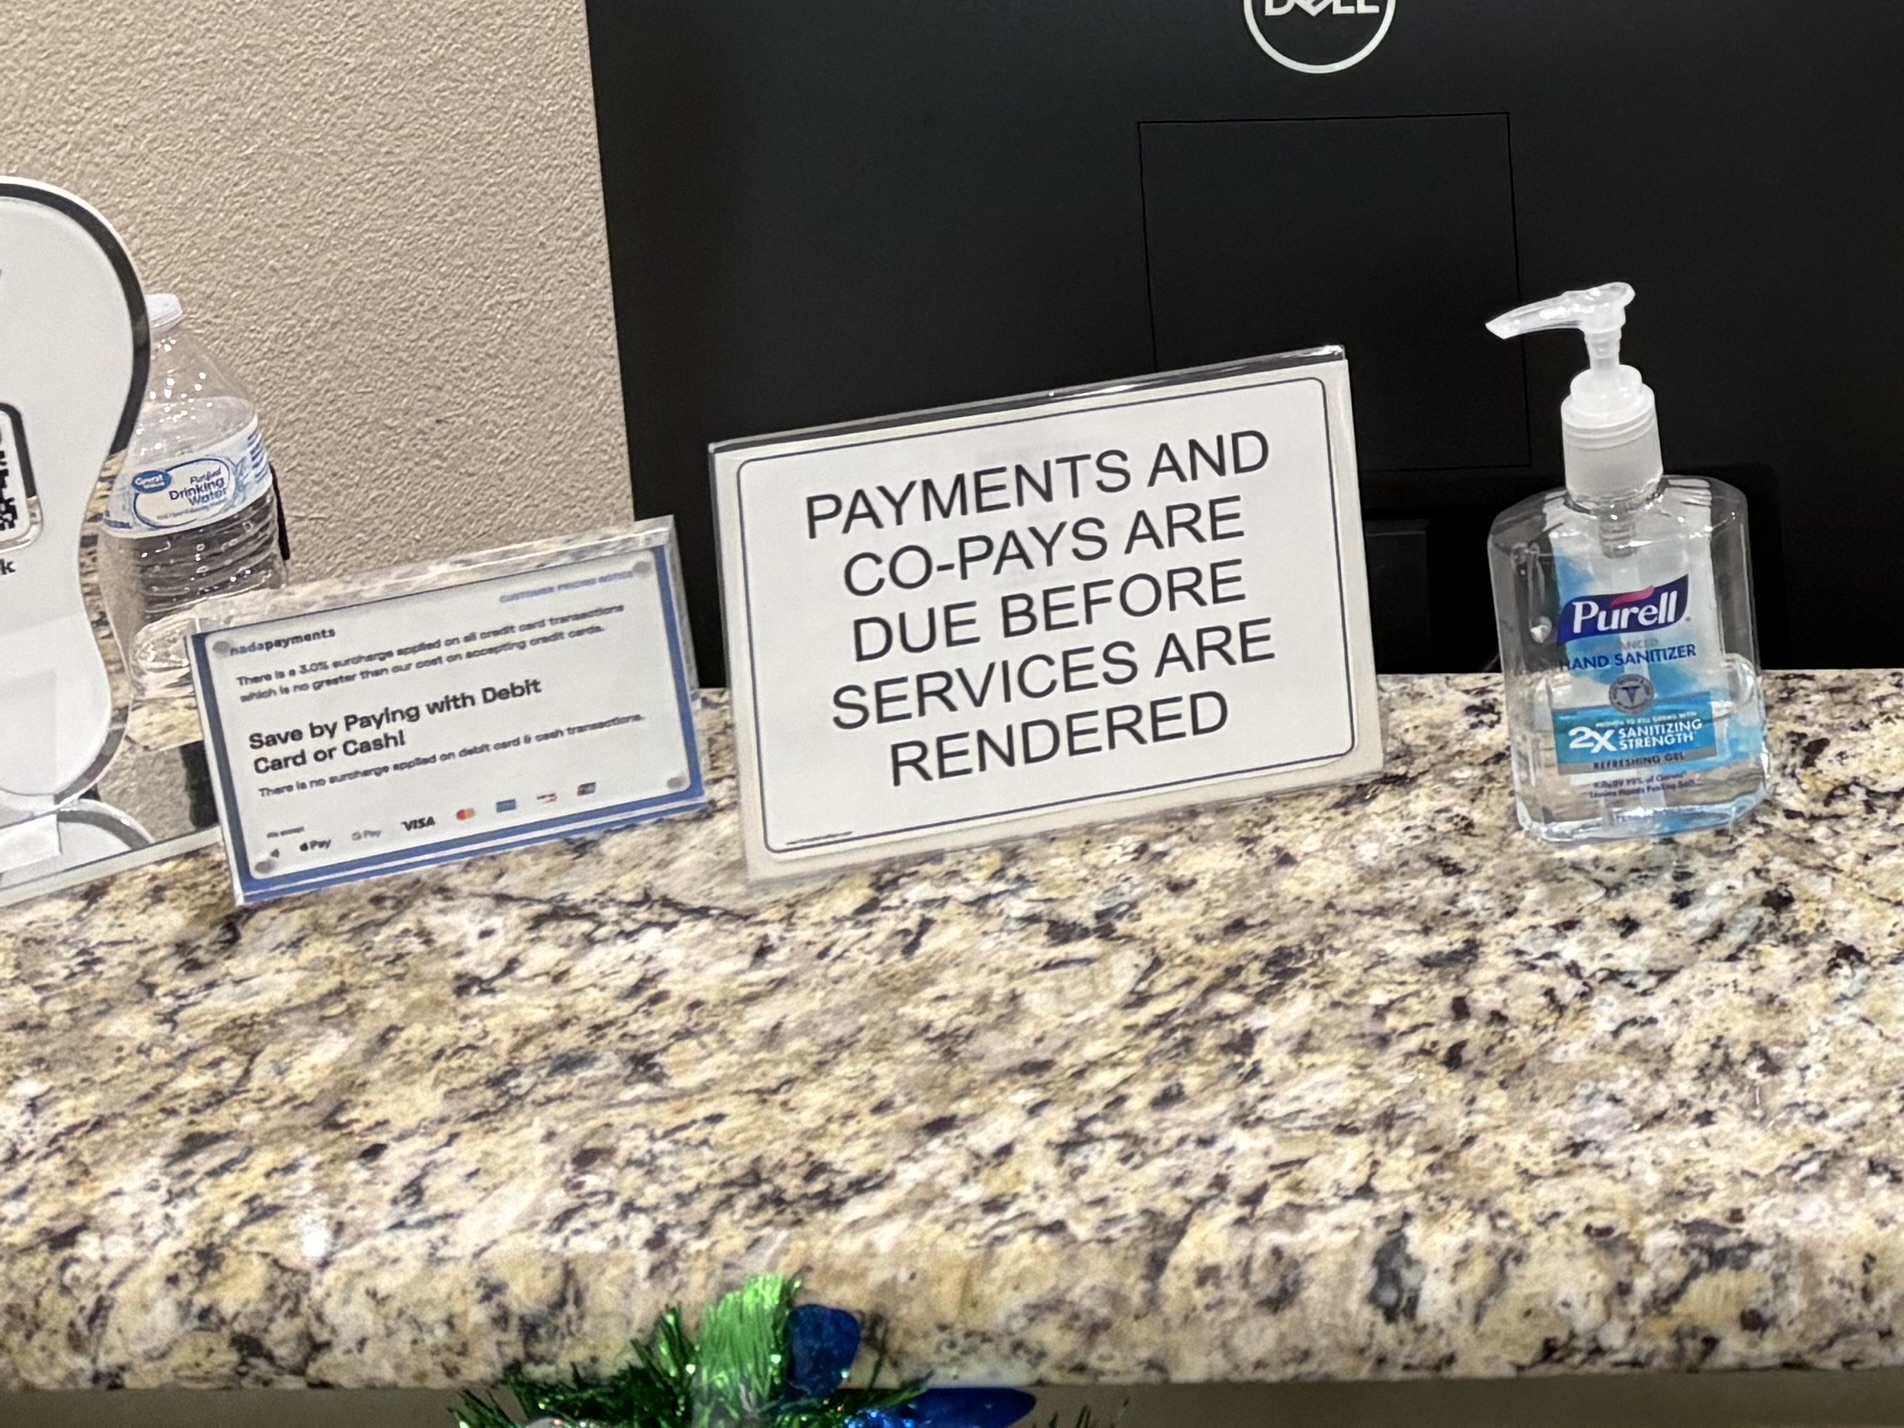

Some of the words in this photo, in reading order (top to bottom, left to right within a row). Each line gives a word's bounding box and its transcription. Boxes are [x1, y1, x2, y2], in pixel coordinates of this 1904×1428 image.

[168, 477, 225, 501] Drinking
[188, 487, 227, 506] Water
[805, 448, 1132, 540] PAYMENTS
[1147, 429, 1270, 489] AND
[843, 516, 1109, 597] CO-PAYS
[1124, 494, 1246, 555] ARE
[237, 672, 272, 687] There
[275, 670, 286, 680] is
[288, 668, 296, 677] a
[299, 661, 329, 675] 3.0%
[332, 649, 394, 669] surcharge
[396, 638, 441, 657] applied
[445, 635, 460, 647] on
[464, 631, 477, 643] all
[480, 625, 516, 640] credit
[519, 618, 546, 632] card
[549, 604, 624, 627] transactions
[852, 600, 981, 663] DUE
[1000, 558, 1247, 639] BEFORE
[1572, 590, 1678, 634] Purell
[240, 687, 277, 703] which
[279, 685, 290, 695] is
[293, 682, 309, 693] no
[312, 671, 357, 691] greater
[359, 666, 389, 681] than
[391, 662, 413, 674] our
[415, 656, 443, 670] cost
[446, 652, 463, 664] on
[465, 638, 527, 660] accepting
[529, 631, 565, 647] credit
[568, 624, 606, 639] cards.
[831, 640, 1139, 730] SERVICES
[1154, 616, 1276, 679] ARE
[1558, 655, 1610, 671] HAND
[1614, 643, 1697, 664] SANITIZER
[249, 728, 304, 750] Save
[309, 720, 338, 739] by
[344, 706, 421, 732] Paying
[426, 692, 476, 715] with
[481, 678, 543, 704] Debit
[889, 690, 1229, 788] RENDERED
[1568, 727, 1618, 754] 2X
[1618, 718, 1703, 740] SANITIZING
[253, 749, 307, 775] Card
[313, 746, 338, 762] or
[342, 729, 406, 756] Cash!
[258, 782, 294, 798] There
[296, 780, 307, 791] is
[309, 777, 326, 789] no
[329, 764, 390, 784] surcharge
[393, 753, 437, 772] applied
[440, 751, 456, 762] on
[458, 742, 490, 758] debit
[493, 736, 521, 751] card
[523, 734, 532, 744] &
[535, 728, 564, 742] cash
[566, 713, 646, 735] transactions.
[1593, 755, 1660, 770] REFRESHING
[1664, 751, 1685, 762] GEL
[401, 816, 436, 832] VISA
